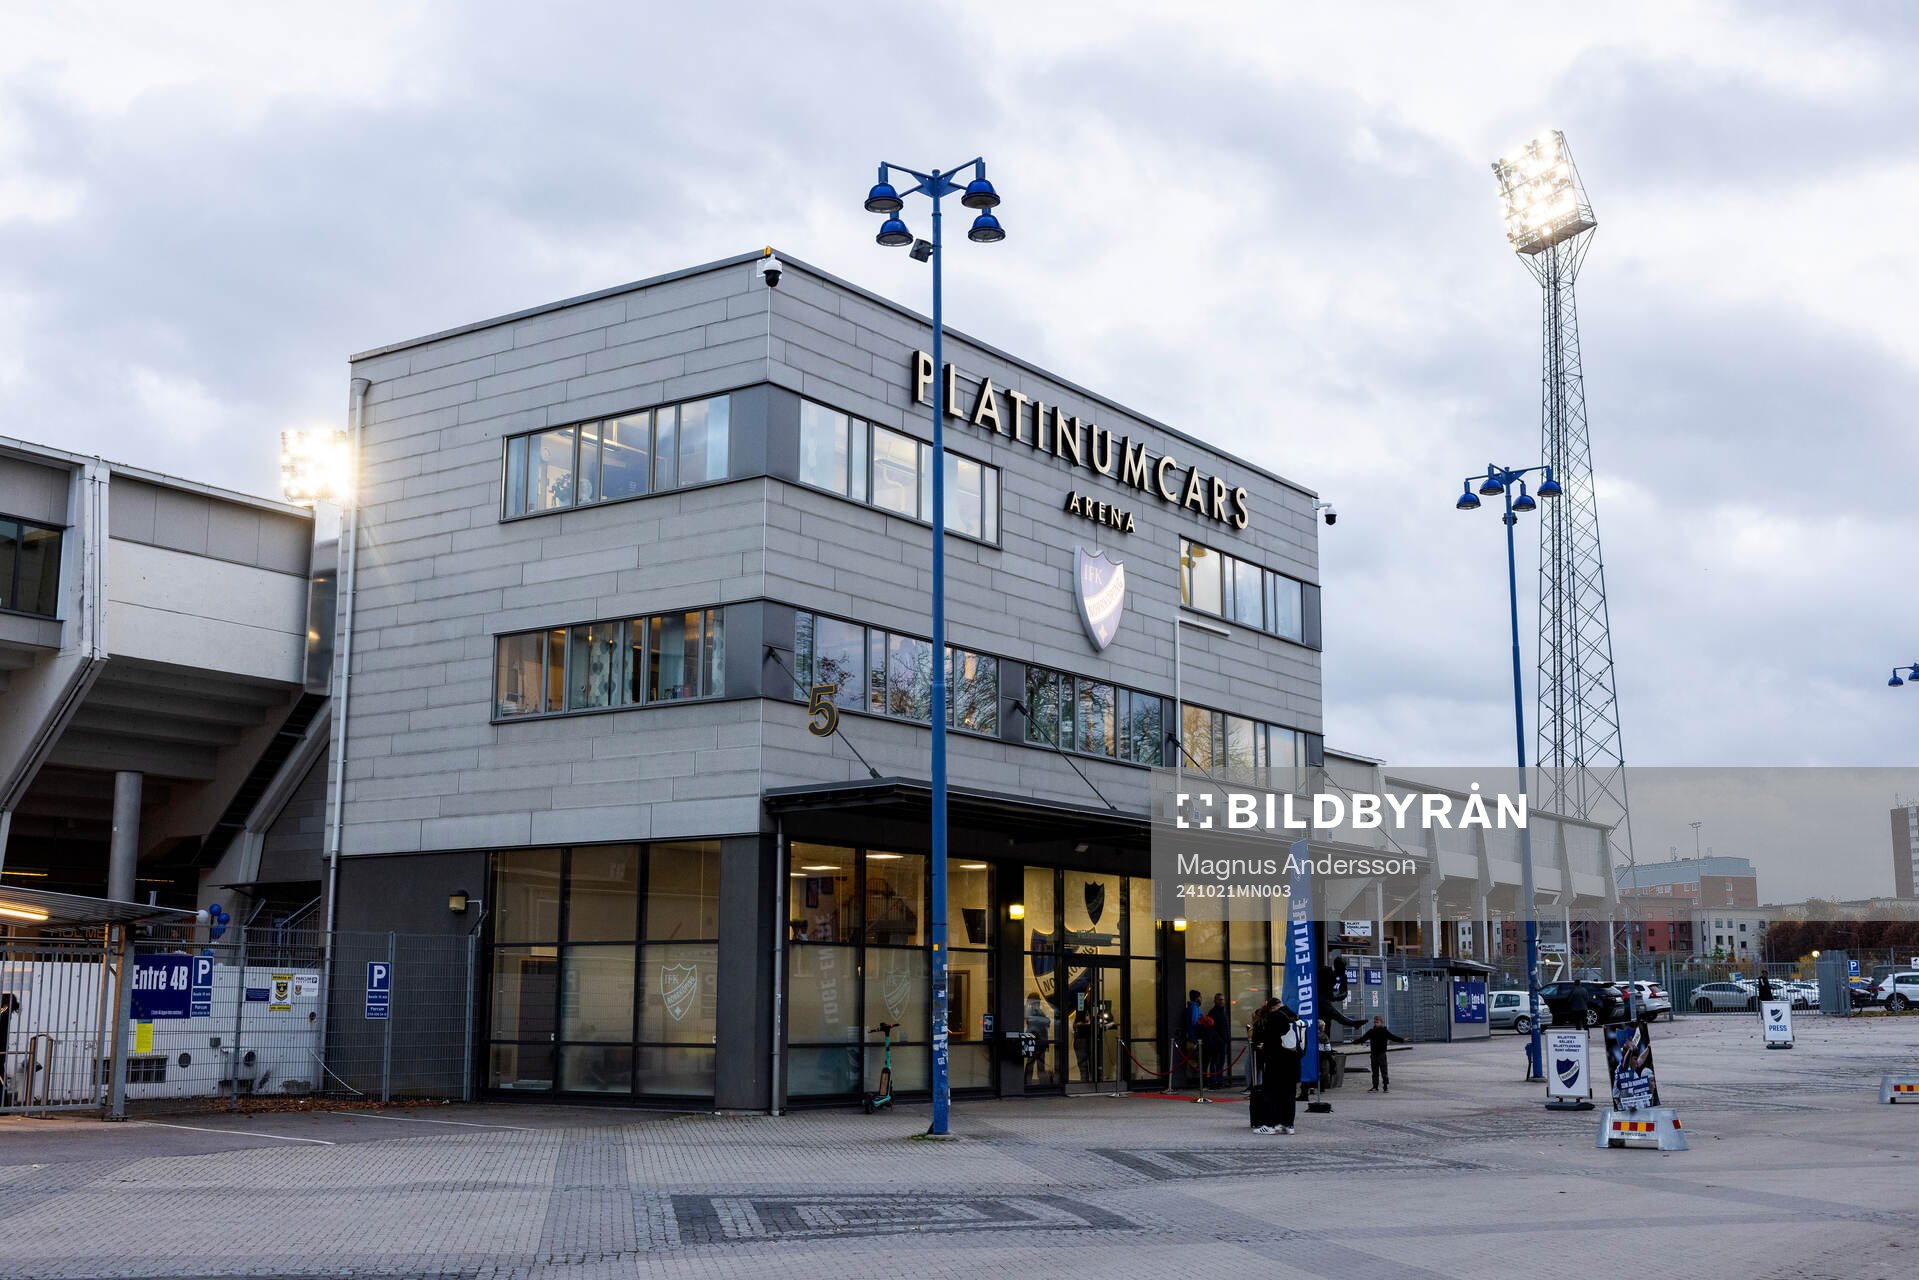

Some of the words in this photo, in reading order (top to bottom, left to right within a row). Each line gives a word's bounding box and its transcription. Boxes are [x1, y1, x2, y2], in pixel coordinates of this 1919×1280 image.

[912, 350, 1249, 530] PLATINUMCARS
[1065, 491, 1136, 535] ARENA
[1082, 565, 1103, 585] IFK
[808, 684, 838, 738] 5
[131, 965, 167, 990] Entré
[170, 965, 188, 991] 4B
[197, 960, 210, 984] P
[373, 965, 387, 988] P
[1850, 961, 1857, 971] P
